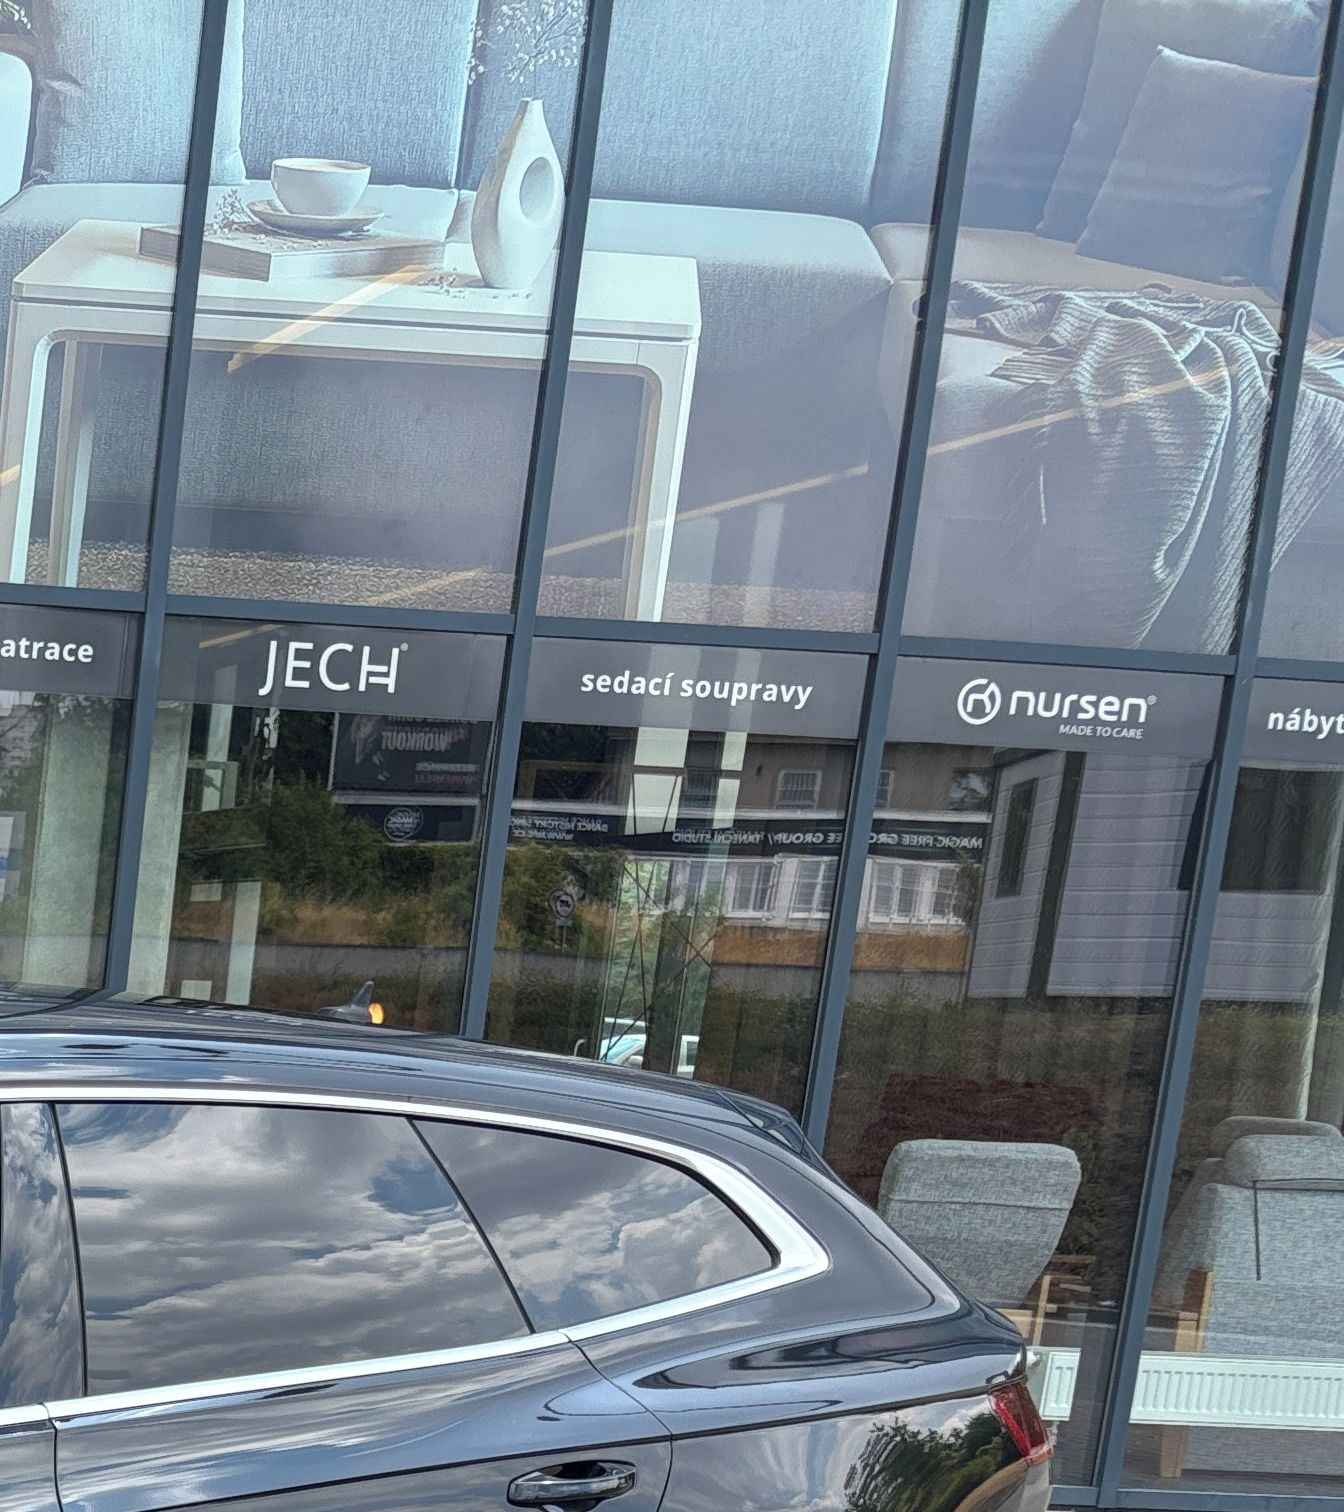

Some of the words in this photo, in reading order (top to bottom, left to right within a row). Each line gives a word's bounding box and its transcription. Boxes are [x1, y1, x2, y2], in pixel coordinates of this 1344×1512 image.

[580, 670, 676, 696] sedací
[679, 679, 814, 710] soupravy
[1058, 724, 1094, 736] MADE
[1095, 726, 1112, 738] TO
[1112, 727, 1144, 740] CARE
